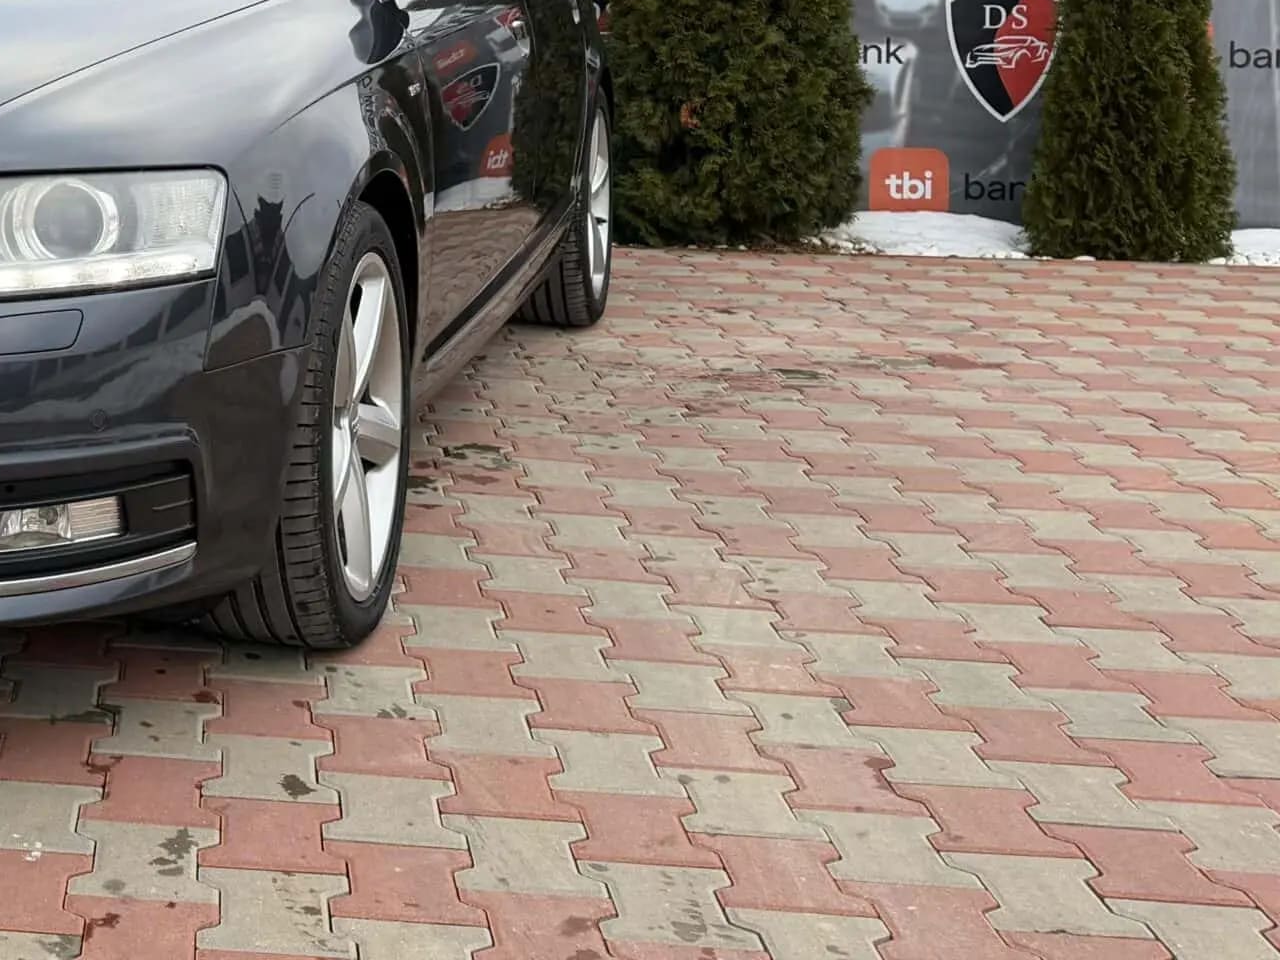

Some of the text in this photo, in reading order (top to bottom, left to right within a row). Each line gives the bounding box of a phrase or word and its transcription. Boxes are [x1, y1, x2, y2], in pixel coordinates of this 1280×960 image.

[983, 4, 1028, 30] DS
[884, 170, 1026, 201] tbi ban
